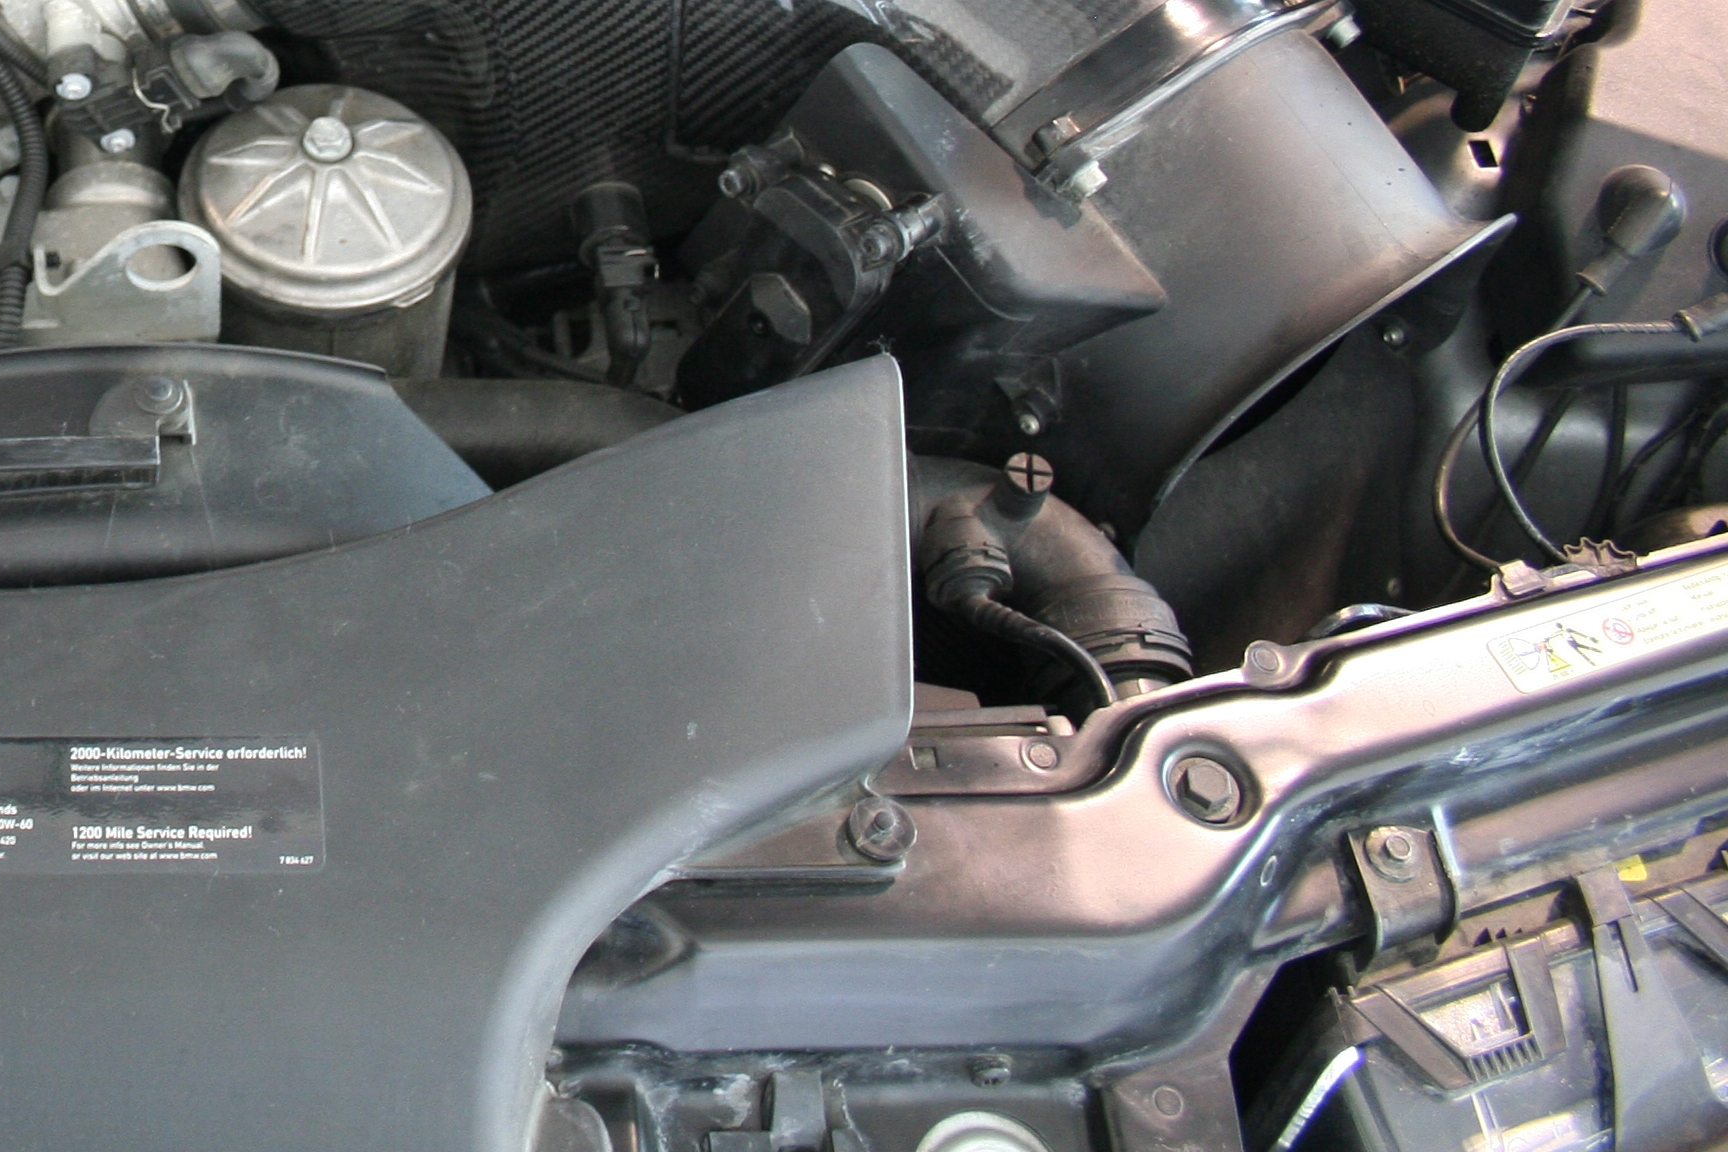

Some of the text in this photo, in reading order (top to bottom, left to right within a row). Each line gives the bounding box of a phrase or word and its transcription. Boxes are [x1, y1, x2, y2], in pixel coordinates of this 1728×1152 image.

[70, 746, 307, 760] 2000-Kilometer-Service erforderlich!
[72, 826, 253, 841] 1200 Mile Service Required!
